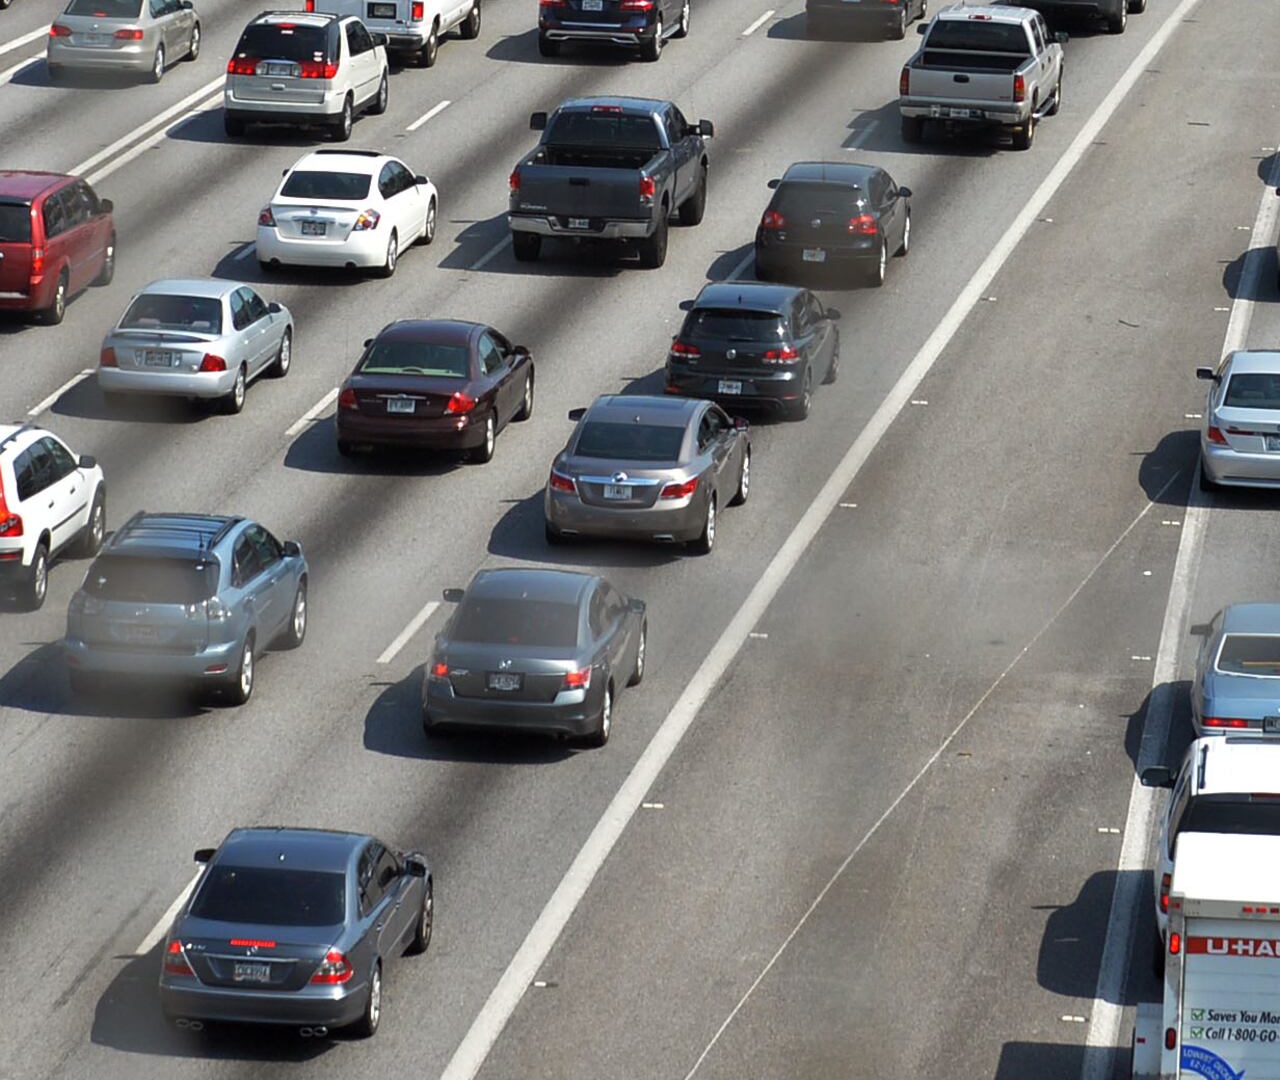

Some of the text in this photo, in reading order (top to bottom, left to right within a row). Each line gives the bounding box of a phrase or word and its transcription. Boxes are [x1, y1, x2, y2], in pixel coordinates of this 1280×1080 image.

[1207, 1009, 1237, 1022] Saves
[1239, 1011, 1258, 1023] You
[1205, 1027, 1226, 1040] Call
